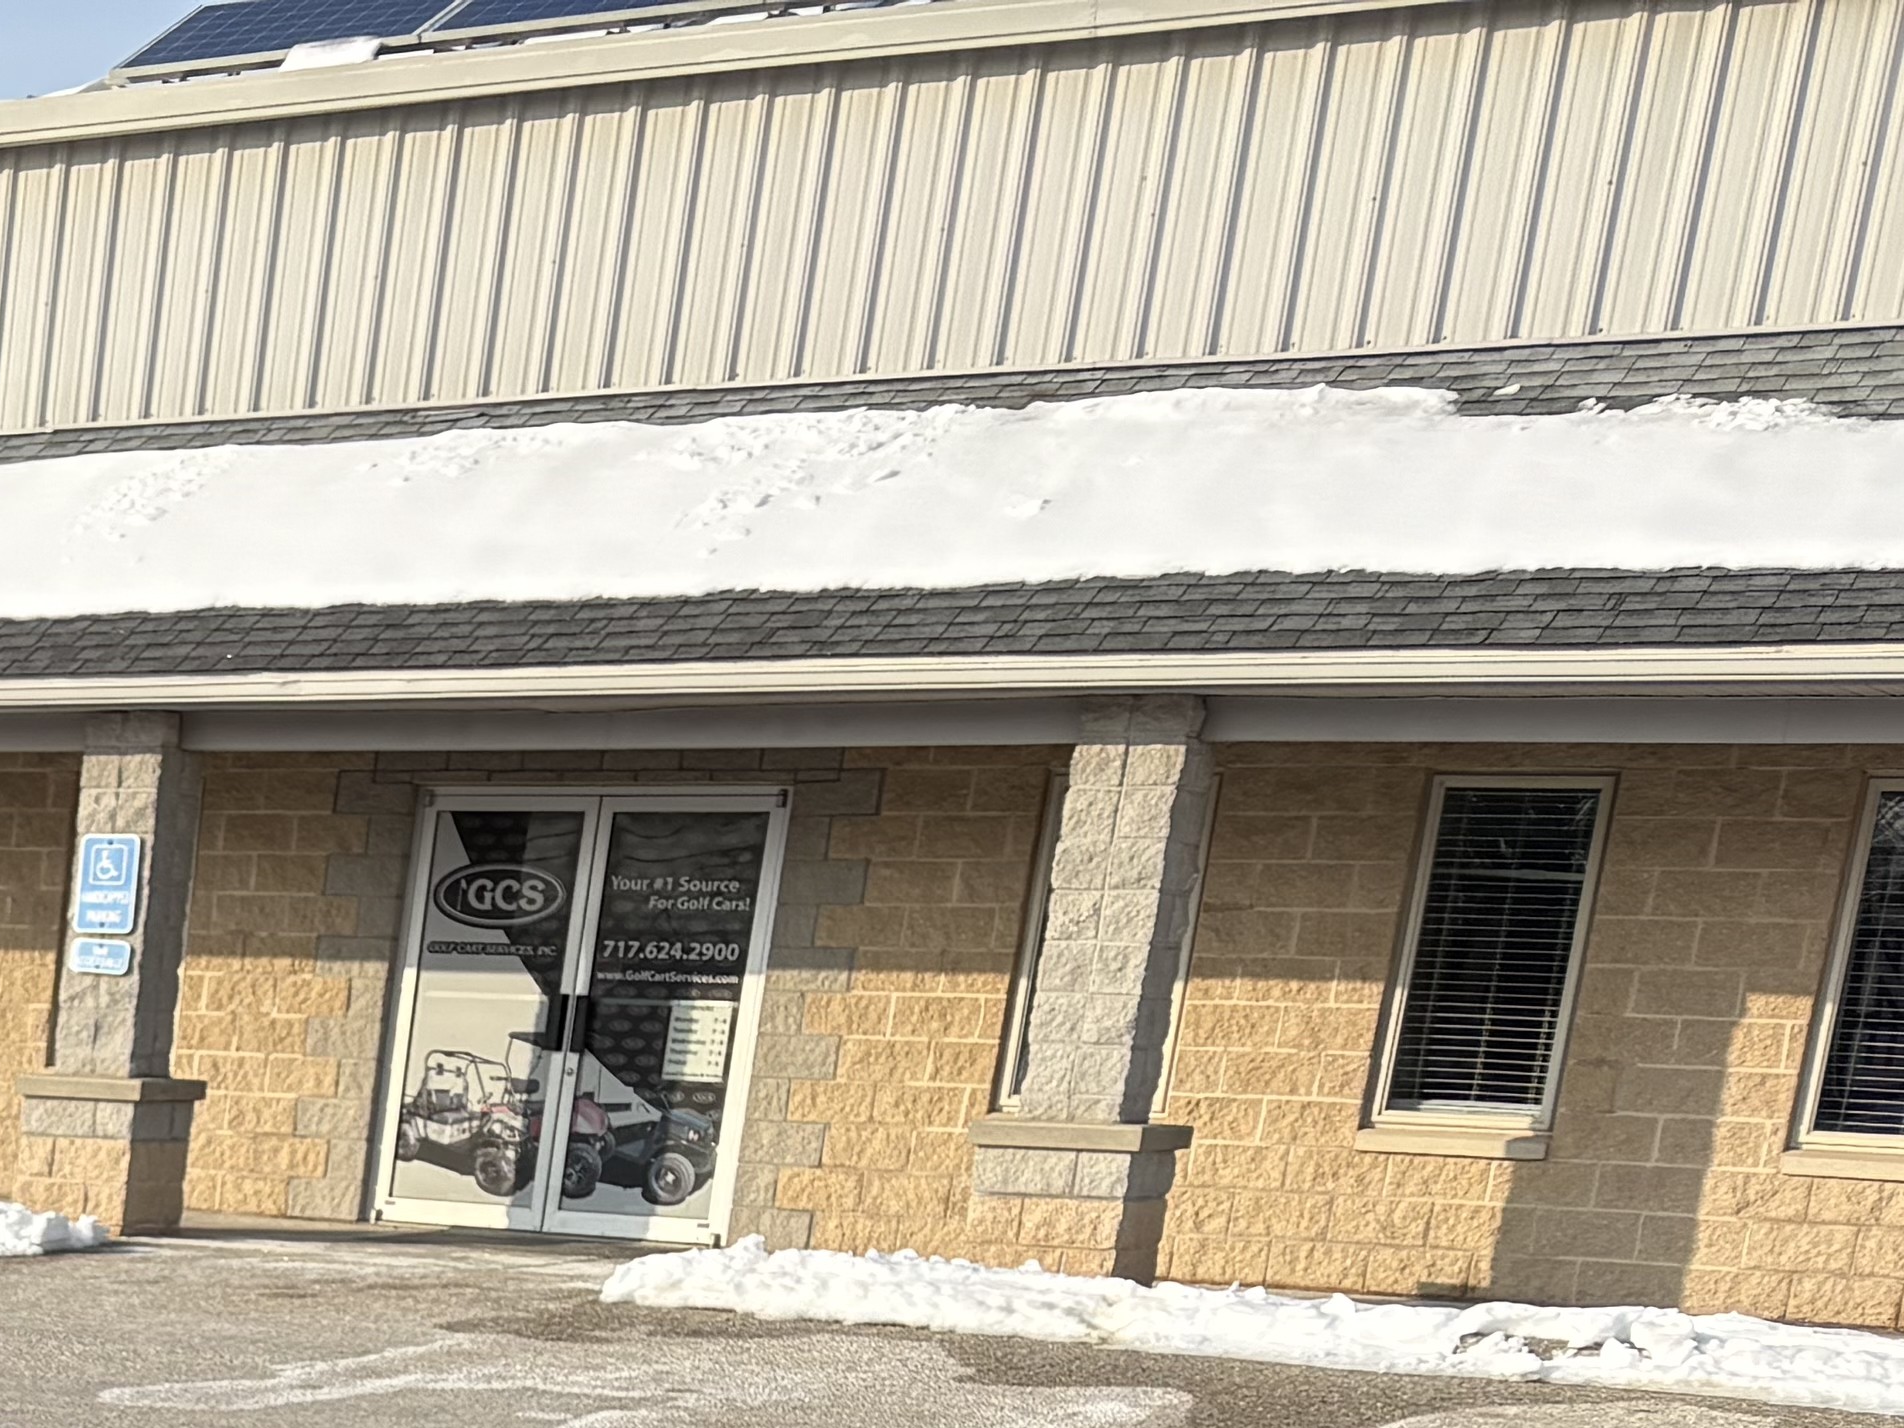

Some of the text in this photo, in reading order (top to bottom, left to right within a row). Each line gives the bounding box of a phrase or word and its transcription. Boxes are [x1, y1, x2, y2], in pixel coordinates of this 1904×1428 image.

[611, 874, 740, 892] Your #1 Source
[467, 877, 547, 912] GCS
[648, 896, 751, 911] For Golf Cars!
[602, 940, 740, 961] 717.624.2900
